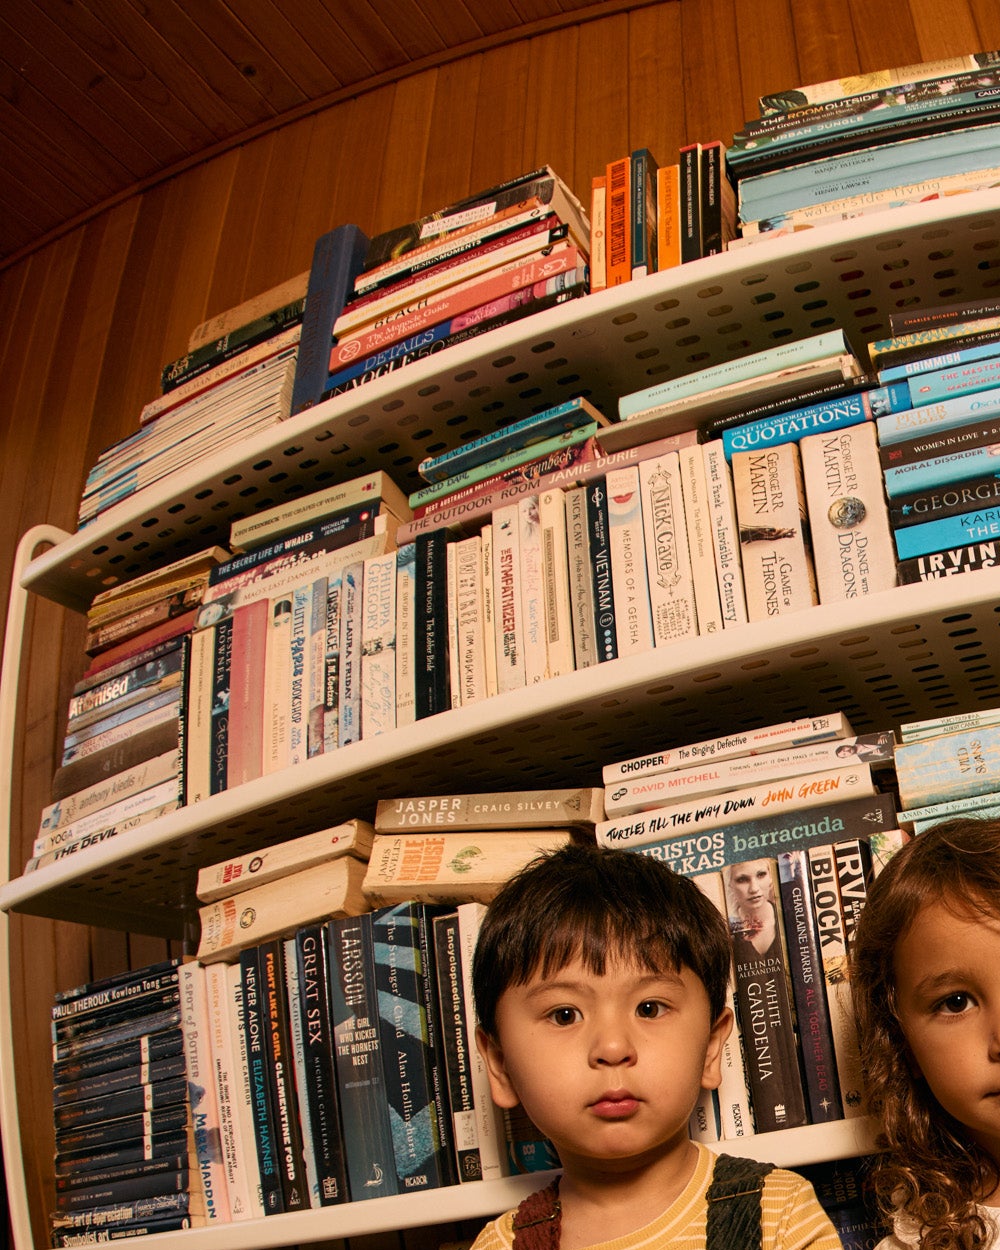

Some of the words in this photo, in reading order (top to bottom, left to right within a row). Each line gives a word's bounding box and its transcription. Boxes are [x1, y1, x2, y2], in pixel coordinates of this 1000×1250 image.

[761, 116, 786, 127] THE
[789, 105, 823, 120] ROOM
[825, 92, 880, 112] OUTSIDE
[771, 127, 813, 141] URBAN
[817, 115, 864, 132] JUNGLE
[367, 331, 384, 343] The
[385, 315, 422, 335] Monocle
[423, 302, 450, 317] Guide
[374, 332, 396, 348] Cozy
[397, 318, 427, 337] Homes
[364, 328, 435, 371] DETAILS
[731, 402, 862, 450] QUOTATIONS
[894, 458, 933, 476] MORAL
[934, 448, 984, 466] DISORDER
[408, 516, 431, 534] THE
[433, 494, 493, 525] OUTDOOR
[500, 479, 541, 502] ROOM
[548, 462, 592, 485] JAMIE
[596, 447, 639, 468] DURIE
[651, 486, 673, 525] Nick
[218, 565, 231, 576] THE
[231, 554, 257, 571] SECRET
[258, 548, 273, 563] LIFE
[273, 543, 284, 554] OF
[284, 531, 314, 550] WHALES
[623, 529, 634, 574] MEMOIRS
[653, 527, 674, 572] Cave
[595, 549, 611, 611] VIETNAM
[625, 578, 635, 591] OF
[761, 552, 779, 617] THRONES
[326, 589, 340, 651] DISGRACE
[628, 607, 639, 645] GEISHA
[620, 755, 664, 774] CHOPPER
[678, 747, 690, 760] The
[691, 742, 716, 759] Singing
[716, 736, 747, 754] Defective
[395, 798, 462, 813] JASPER
[473, 803, 512, 815] CRAIG
[516, 799, 561, 812] SILVEY
[761, 789, 794, 807] JOHN
[798, 776, 841, 799] GREEN
[398, 811, 457, 825] JONES
[606, 824, 645, 843] TURTLES
[648, 816, 669, 833] ALL
[669, 811, 691, 828] THE
[695, 804, 721, 822] WAY
[723, 797, 756, 815] DOWN
[733, 816, 845, 854] barracuda
[811, 859, 843, 947] BLOCK
[245, 967, 256, 1007] NEVER
[303, 937, 318, 1000] GREAT
[341, 926, 366, 1007] LARSSON
[52, 1004, 73, 1018] PAUL
[73, 993, 110, 1012] THEROUX
[111, 983, 141, 1000] Kowloon
[142, 979, 161, 992] Tong
[765, 978, 781, 1028] WHITE
[247, 1011, 260, 1053] ALONE
[307, 1004, 322, 1046] SEX
[747, 982, 773, 1081] GARDENIA
[252, 1059, 267, 1122] ELIZABETH
[259, 1124, 274, 1176] HAYNES
